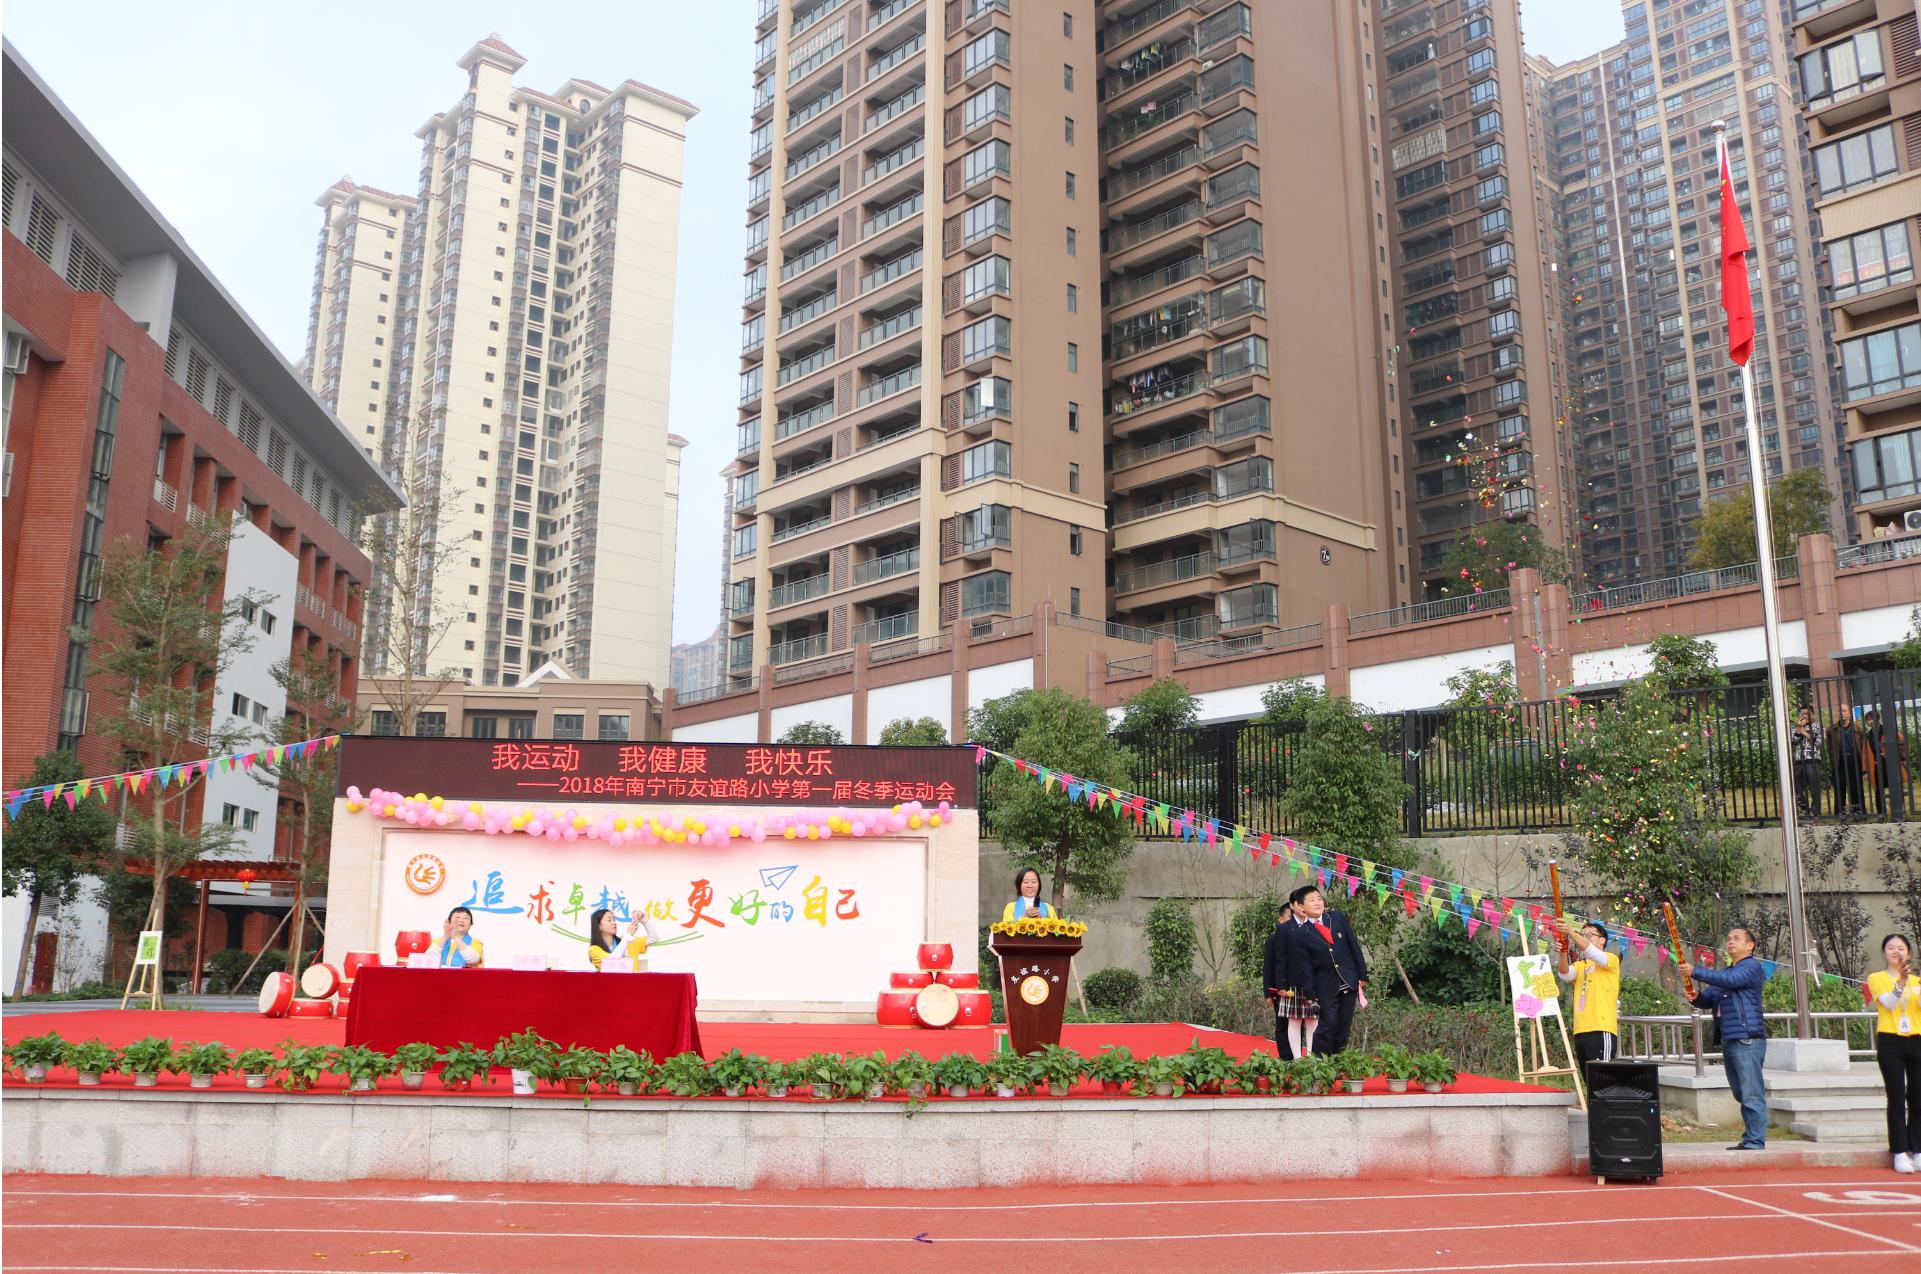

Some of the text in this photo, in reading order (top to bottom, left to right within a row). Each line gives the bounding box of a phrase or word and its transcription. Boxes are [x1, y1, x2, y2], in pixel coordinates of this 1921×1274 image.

[491, 743, 833, 776] 我运动 我健康 我快乐
